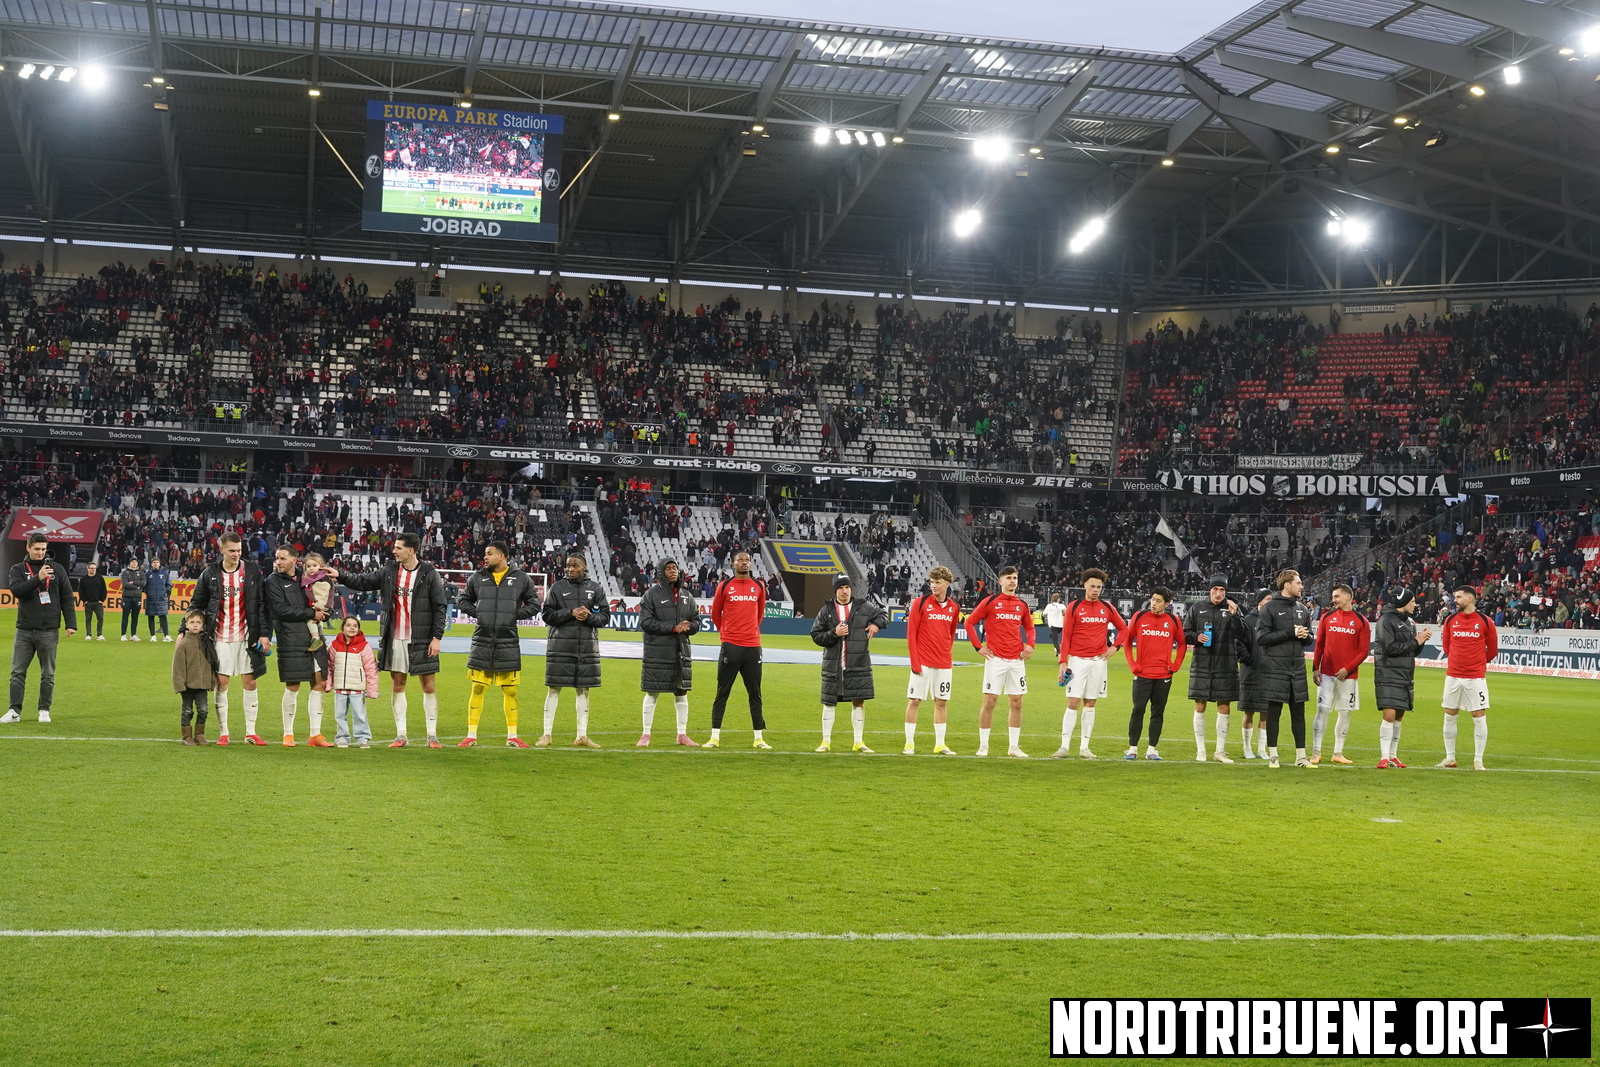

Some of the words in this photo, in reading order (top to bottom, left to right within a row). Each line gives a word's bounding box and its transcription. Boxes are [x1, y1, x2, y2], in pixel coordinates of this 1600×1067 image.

[384, 105, 449, 122] EUROPA
[455, 111, 498, 126] PARK
[503, 114, 548, 129] Stadion
[420, 217, 501, 237] JOBRAD
[212, 402, 248, 411] JBRD
[50, 428, 83, 437] Badenova
[109, 431, 142, 440] Badenova
[167, 434, 201, 443] Badenova
[225, 437, 259, 446] Badenova
[283, 439, 316, 448] Badenova
[397, 445, 429, 455] Badenova
[450, 447, 474, 457] Ford
[490, 449, 541, 460] ernst
[542, 451, 553, 460] +
[554, 451, 601, 464] könig
[653, 457, 702, 468] ernst
[703, 459, 714, 468] +
[715, 458, 762, 472] könig
[1238, 455, 1329, 469] BEGLEITSERVICE
[812, 466, 859, 475] ernst
[872, 467, 917, 480] könig
[1565, 472, 1581, 481] testo
[1006, 477, 1025, 485] PLUS
[1296, 474, 1451, 497] BORUSSIA
[1469, 481, 1483, 489] testo
[1515, 477, 1531, 485] testo
[789, 565, 840, 573] EDEKA
[928, 613, 953, 622] JOBRAD
[995, 613, 1022, 621] JOBRAD
[1141, 629, 1170, 638] JOBRAD
[1328, 625, 1356, 635] JOBRAD
[1501, 635, 1529, 646] PROJEKT
[1531, 637, 1551, 647] KRAFT
[1568, 638, 1598, 650] PROJEKT
[1487, 664, 1520, 673] WeberHaus
[1578, 656, 1600, 671] WA
[1521, 666, 1555, 676] WeberHaus
[1557, 669, 1594, 679] WeberHaus
[939, 681, 951, 693] 69
[1479, 691, 1486, 702] 5
